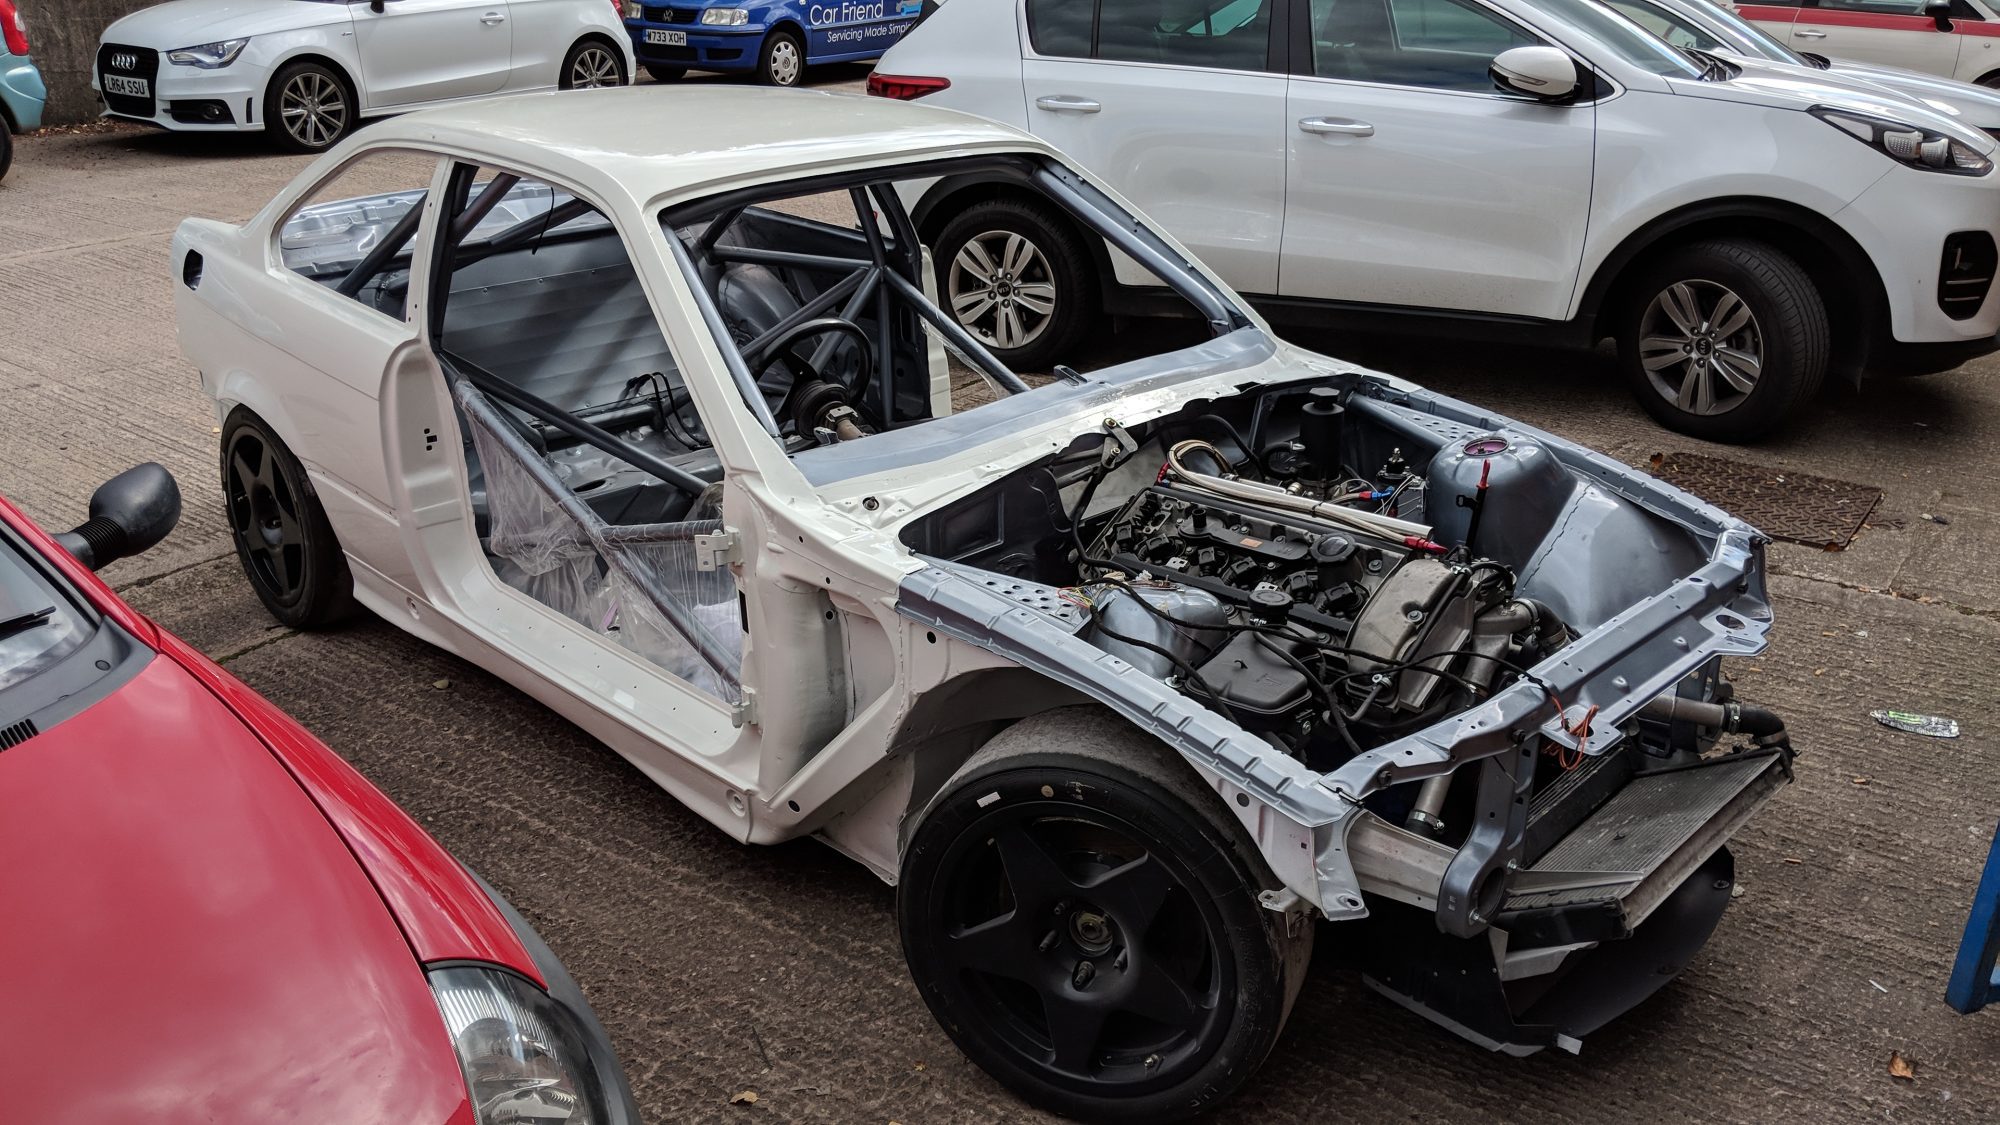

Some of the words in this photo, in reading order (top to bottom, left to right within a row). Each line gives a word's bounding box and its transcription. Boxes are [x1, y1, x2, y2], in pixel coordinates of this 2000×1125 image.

[810, 5, 838, 25] Car
[842, 0, 884, 22] Friend
[647, 31, 667, 42] W733
[668, 32, 685, 44] XOH
[827, 28, 863, 43] Servicing
[864, 25, 887, 37] Made
[107, 76, 126, 92] LR64
[127, 80, 145, 95] SSU
